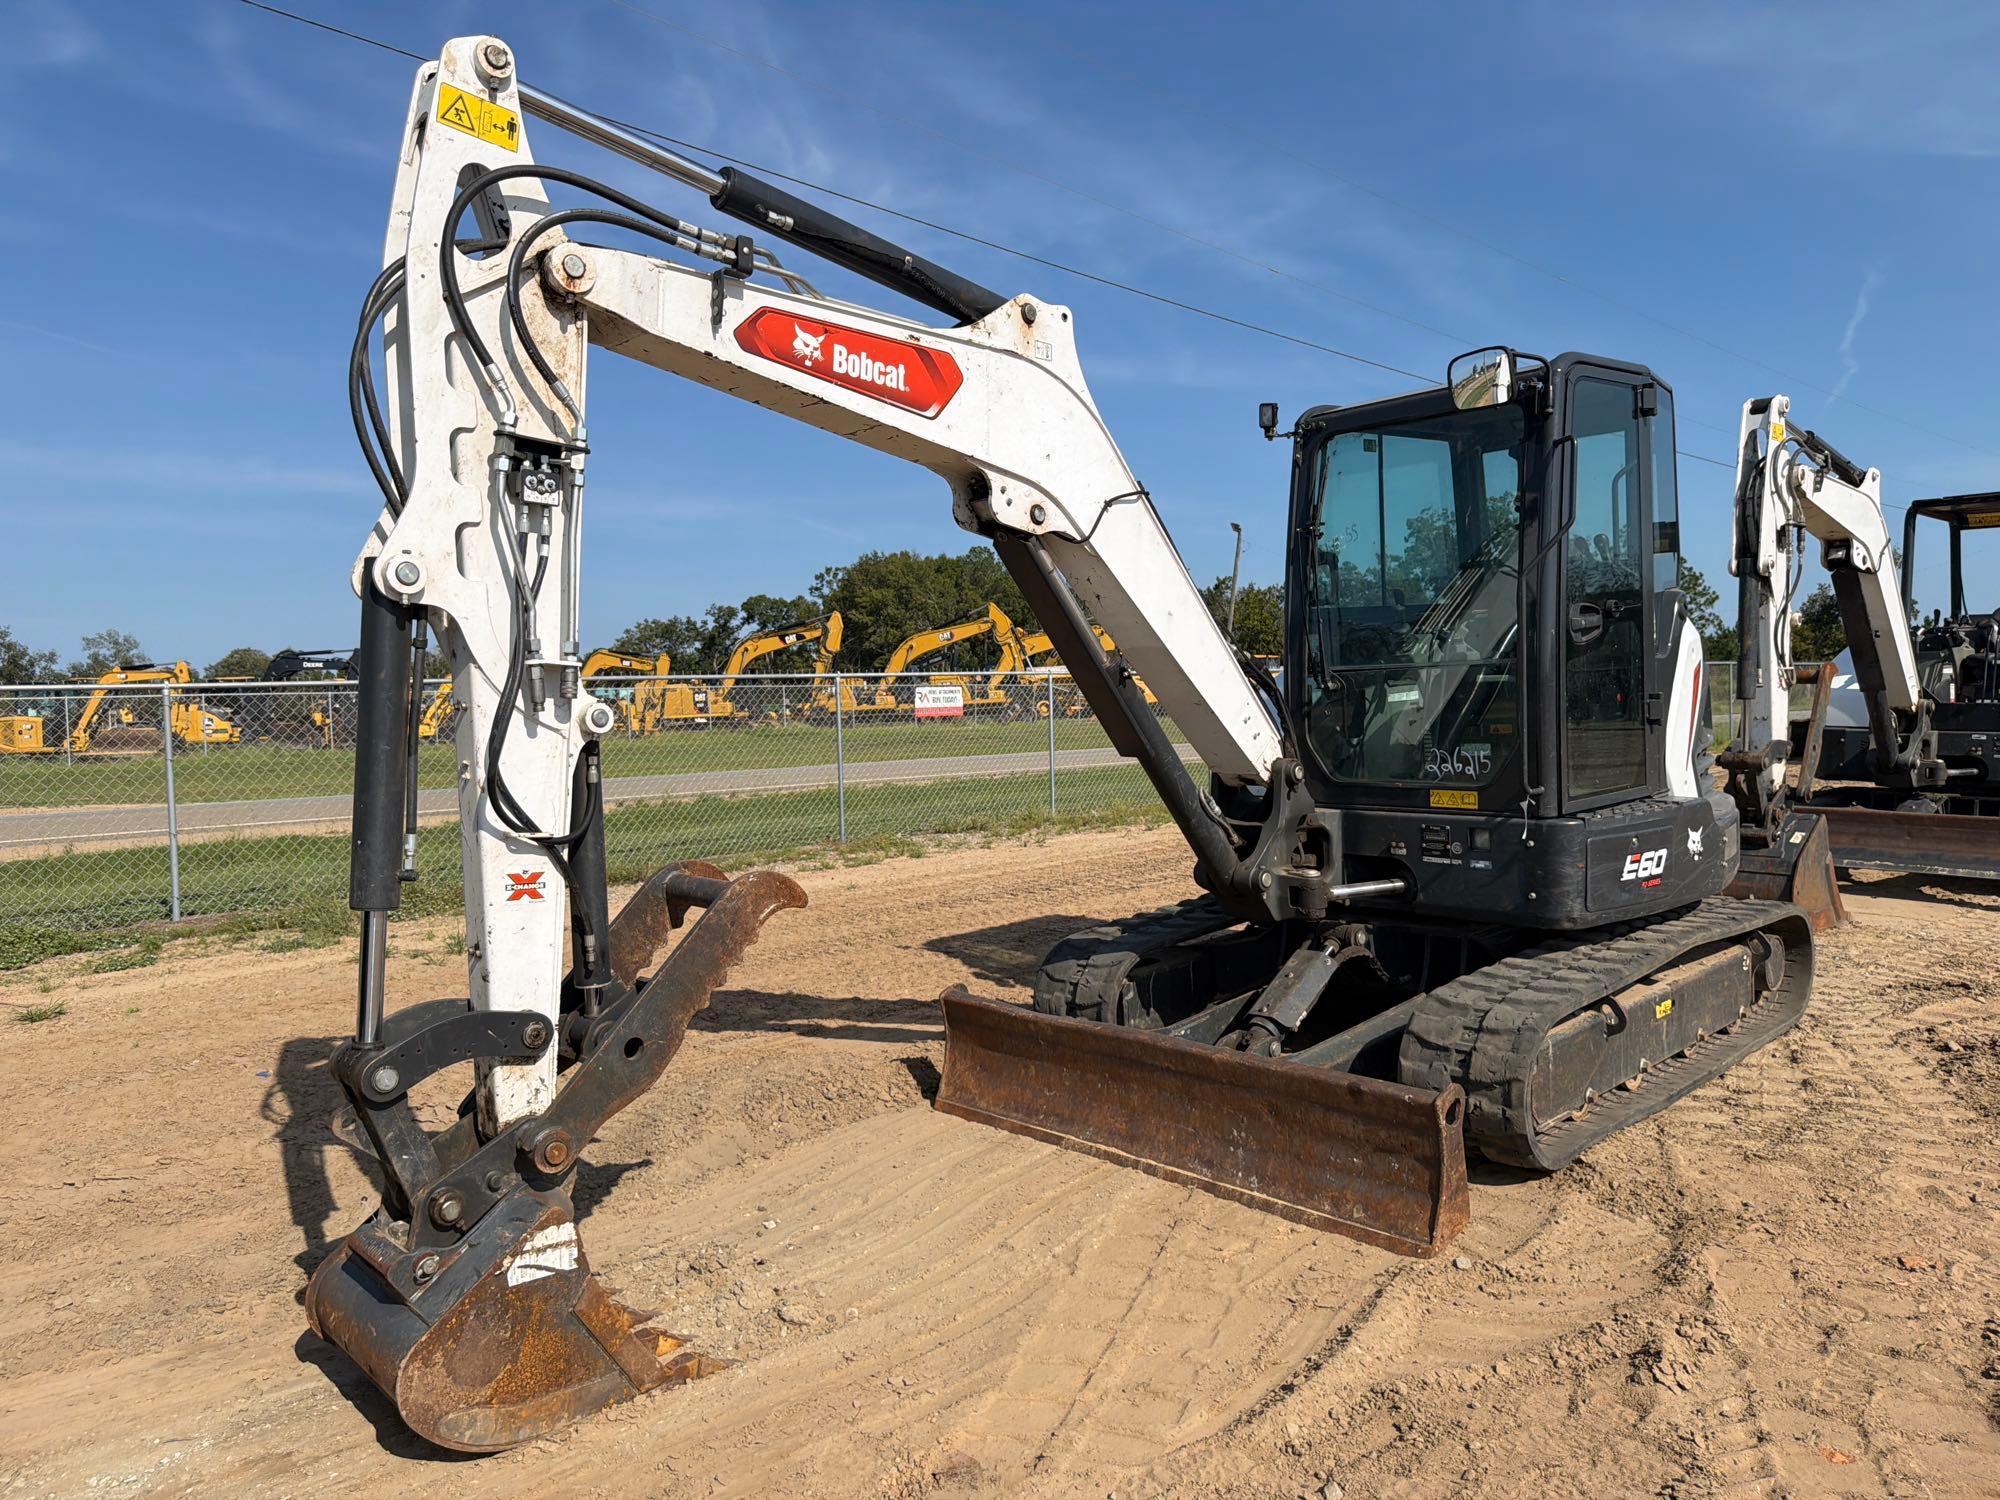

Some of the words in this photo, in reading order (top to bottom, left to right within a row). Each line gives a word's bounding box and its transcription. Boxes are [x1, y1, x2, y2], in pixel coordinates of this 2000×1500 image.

[833, 343, 907, 392] Bobcat
[785, 633, 797, 644] CAT
[939, 631, 952, 641] CAT
[694, 693, 706, 702] CAT
[1426, 746, 1492, 784] 226215
[1620, 848, 1668, 881] E60
